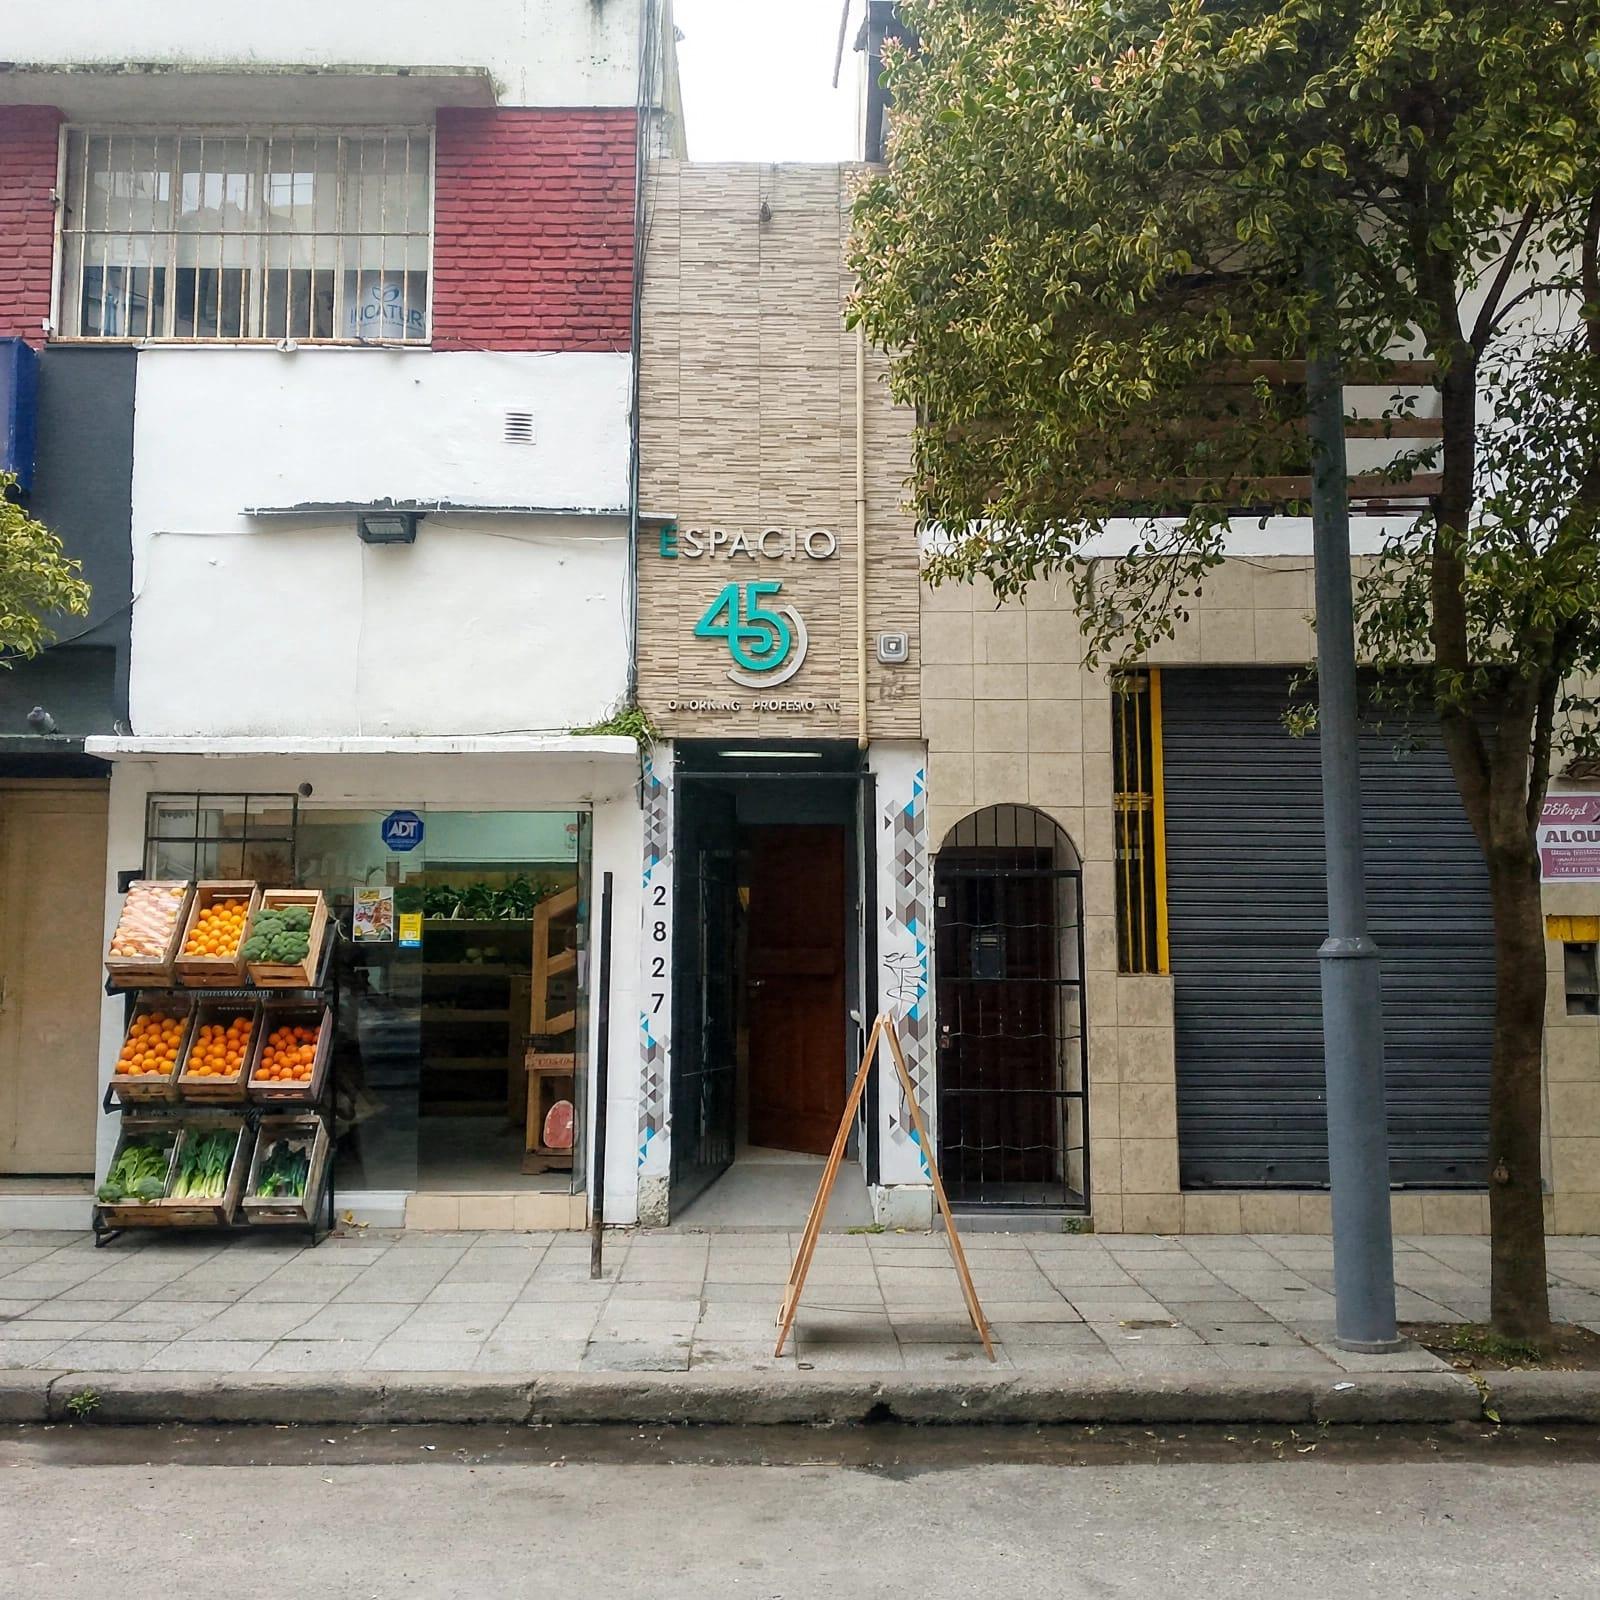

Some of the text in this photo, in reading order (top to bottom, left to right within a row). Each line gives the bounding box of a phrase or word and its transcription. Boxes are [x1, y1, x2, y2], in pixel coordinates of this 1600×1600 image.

[660, 525, 836, 559] ESPACIO
[693, 581, 790, 671] 45
[388, 821, 418, 838] ADT
[651, 885, 667, 1014] 2827
